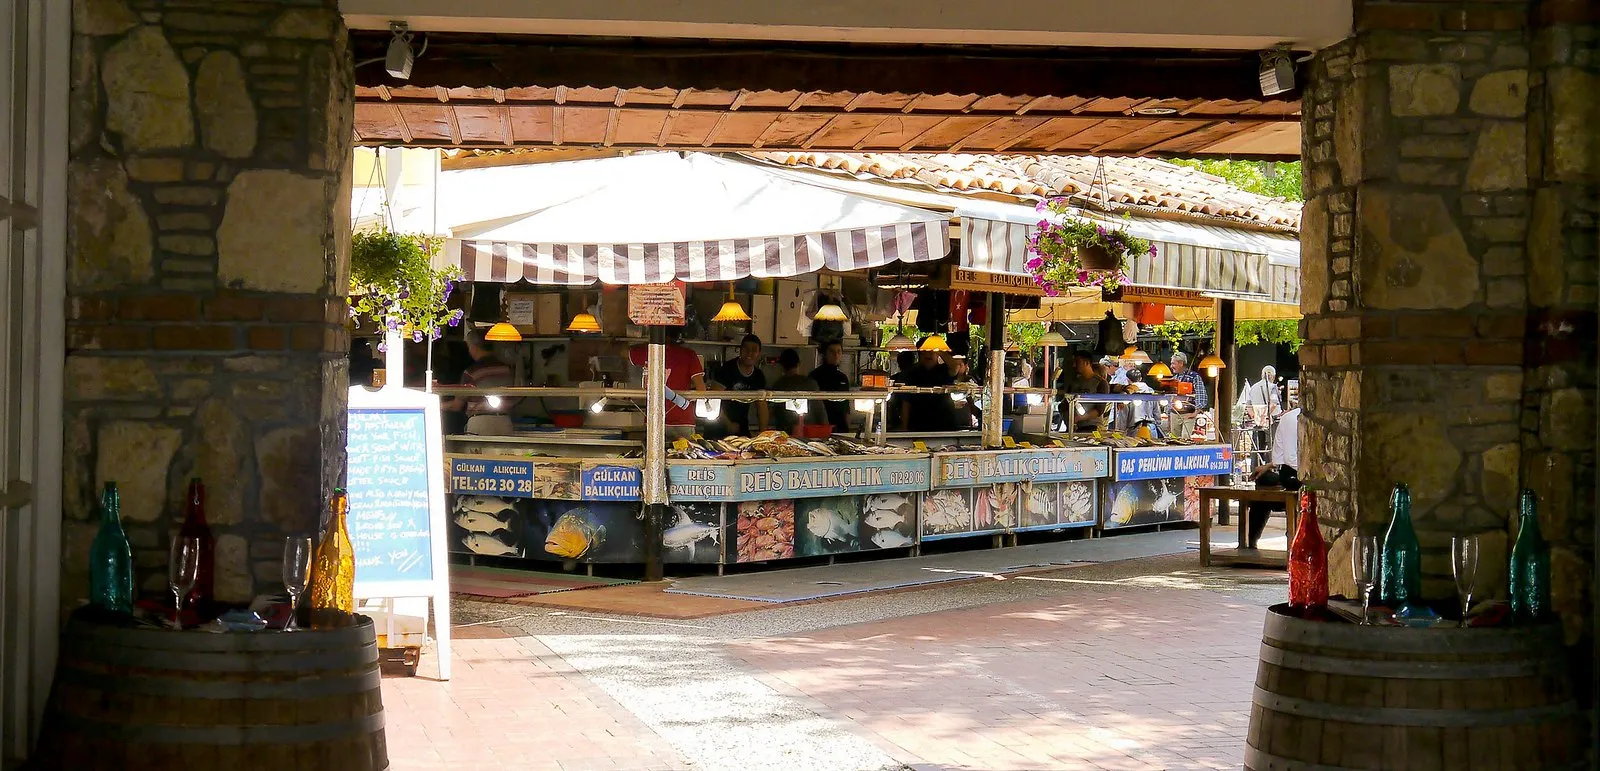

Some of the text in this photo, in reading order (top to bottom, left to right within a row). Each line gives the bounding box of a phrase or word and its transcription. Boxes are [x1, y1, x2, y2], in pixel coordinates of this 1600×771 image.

[456, 463, 527, 475] GÜLKAN ALIKÇILIK
[499, 479, 515, 492] 30
[517, 479, 532, 493] 28
[740, 466, 785, 493] REİS
[788, 466, 884, 493] BALIKÇILIK
